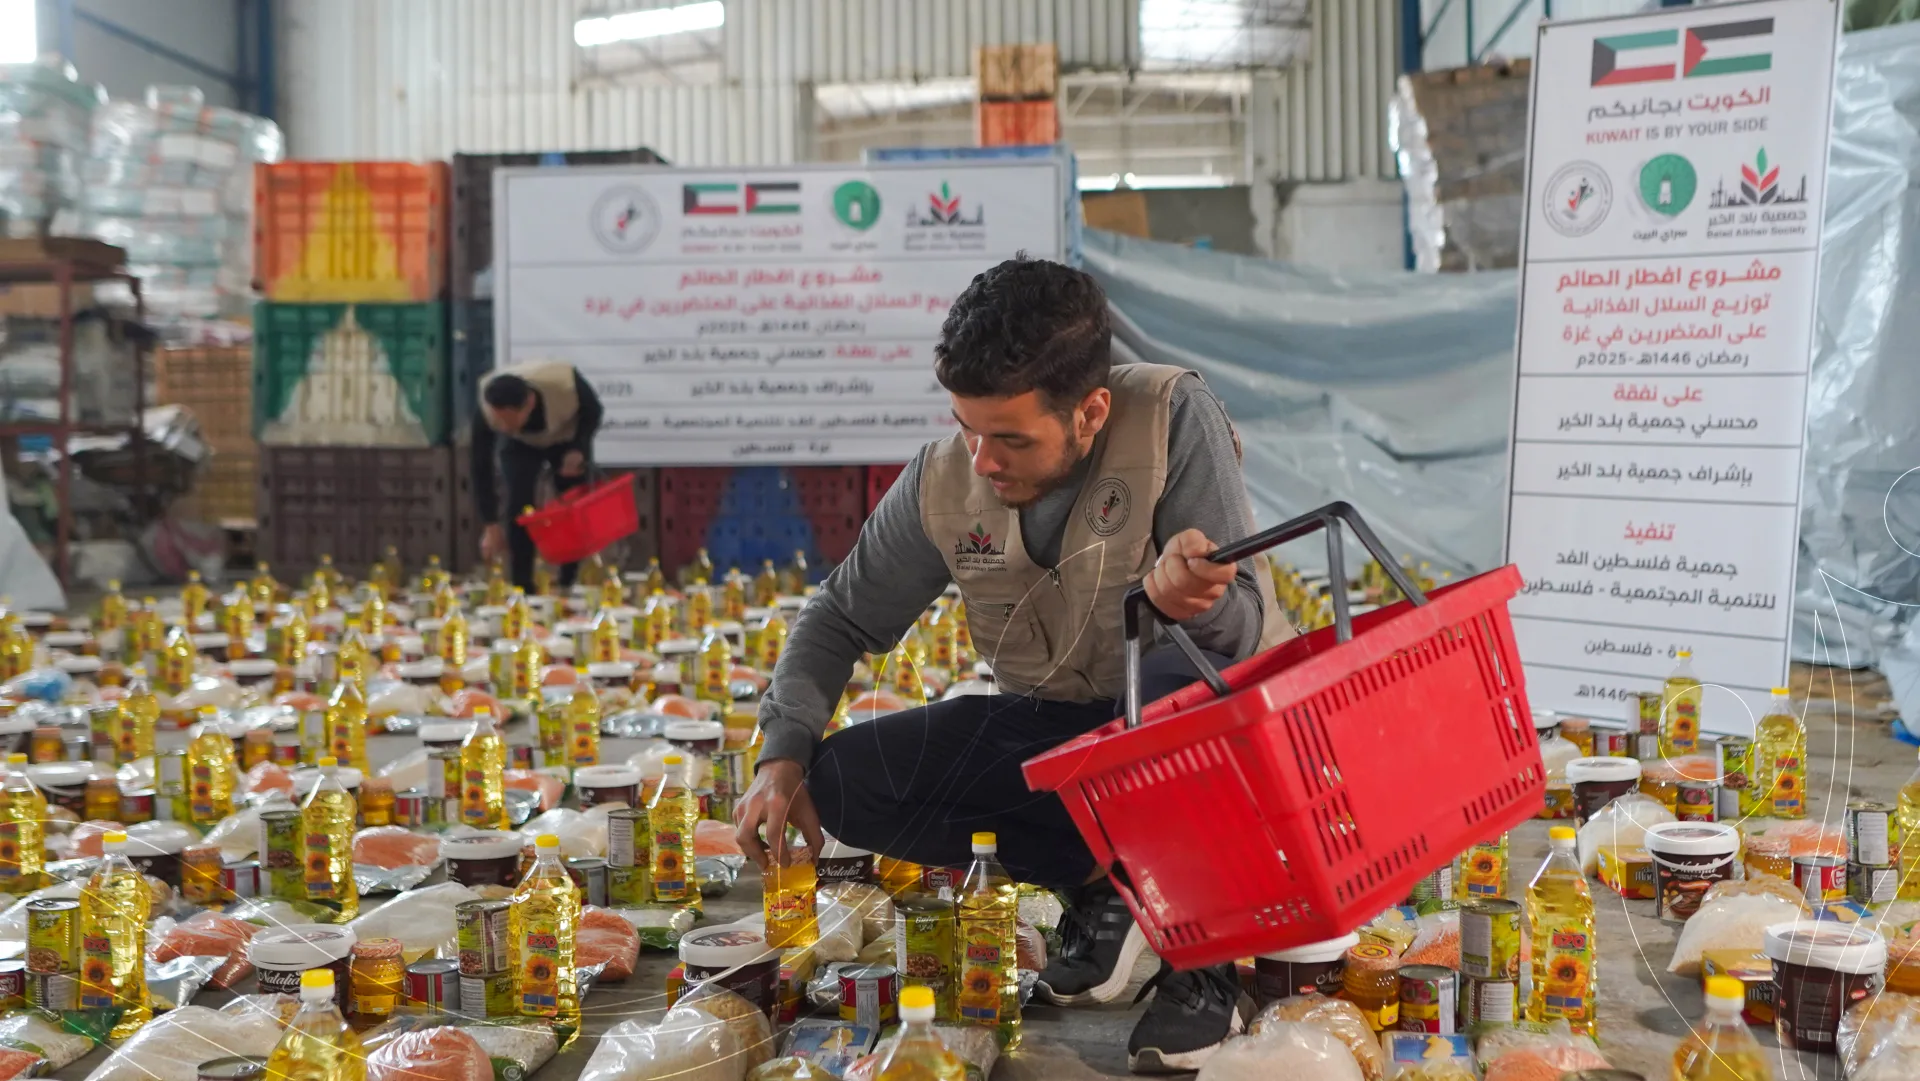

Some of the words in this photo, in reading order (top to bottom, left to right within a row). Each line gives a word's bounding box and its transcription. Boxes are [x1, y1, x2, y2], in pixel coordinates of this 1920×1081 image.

[1687, 86, 1771, 111] الكويت
[1587, 97, 1682, 124] بجانبكم
[1586, 129, 1641, 145] KUWAIT
[1646, 127, 1659, 141] IS
[1664, 125, 1683, 139] BY
[1688, 121, 1728, 137] YOUR
[1733, 116, 1769, 132] SIDE
[1563, 296, 1640, 319] الغذائية
[1644, 295, 1706, 317] السلال
[1712, 293, 1772, 317] توزيع
[1563, 325, 1591, 346] غزة
[1597, 325, 1623, 350] في
[1628, 323, 1722, 346] المتضررين
[1727, 322, 1767, 345] على
[1696, 350, 1749, 368] رمضان
[1613, 383, 1658, 402] نفقة
[1662, 386, 1703, 407] على
[1557, 412, 1592, 432] الخير
[1598, 413, 1624, 432] بلد
[1627, 412, 1686, 433] جمعية
[1691, 413, 1758, 439] محسني
[1556, 462, 1592, 481] الخير
[1596, 463, 1622, 480] بلد
[1627, 462, 1682, 484] جمعية
[1688, 462, 1754, 488] بإشراف
[1624, 520, 1676, 545] تنفيذ
[1555, 549, 1589, 567] الغد
[1593, 552, 1671, 573] فلسطين
[1676, 559, 1739, 581] جمعية
[1521, 576, 1594, 597] فلسطين
[1610, 584, 1702, 607] المجتمعية
[1708, 590, 1777, 613] للتنمية
[1584, 638, 1653, 657] فلسطين
[817, 863, 860, 877] Natalia
